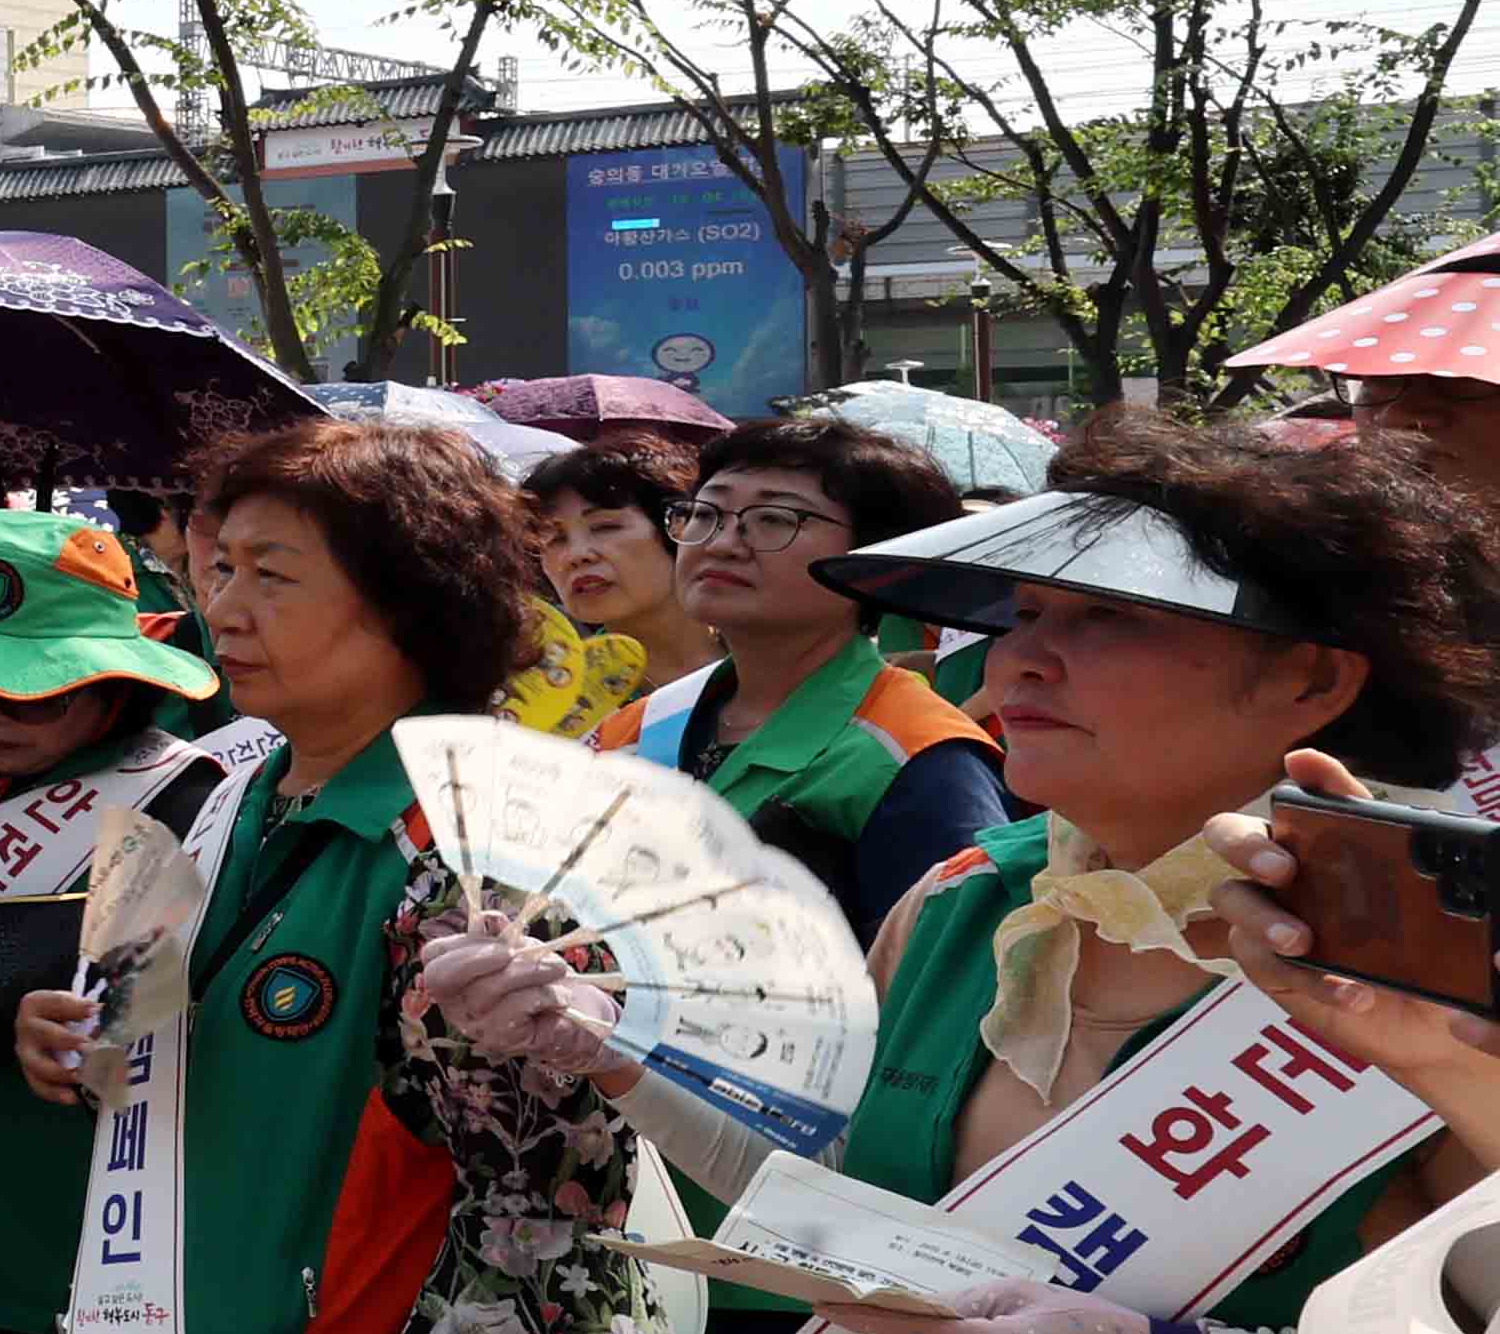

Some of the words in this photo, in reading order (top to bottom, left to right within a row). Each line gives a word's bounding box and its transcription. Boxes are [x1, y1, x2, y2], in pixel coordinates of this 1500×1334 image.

[697, 221, 762, 245] (SO2)
[617, 259, 685, 282] 0.003
[692, 259, 744, 282] ppm
